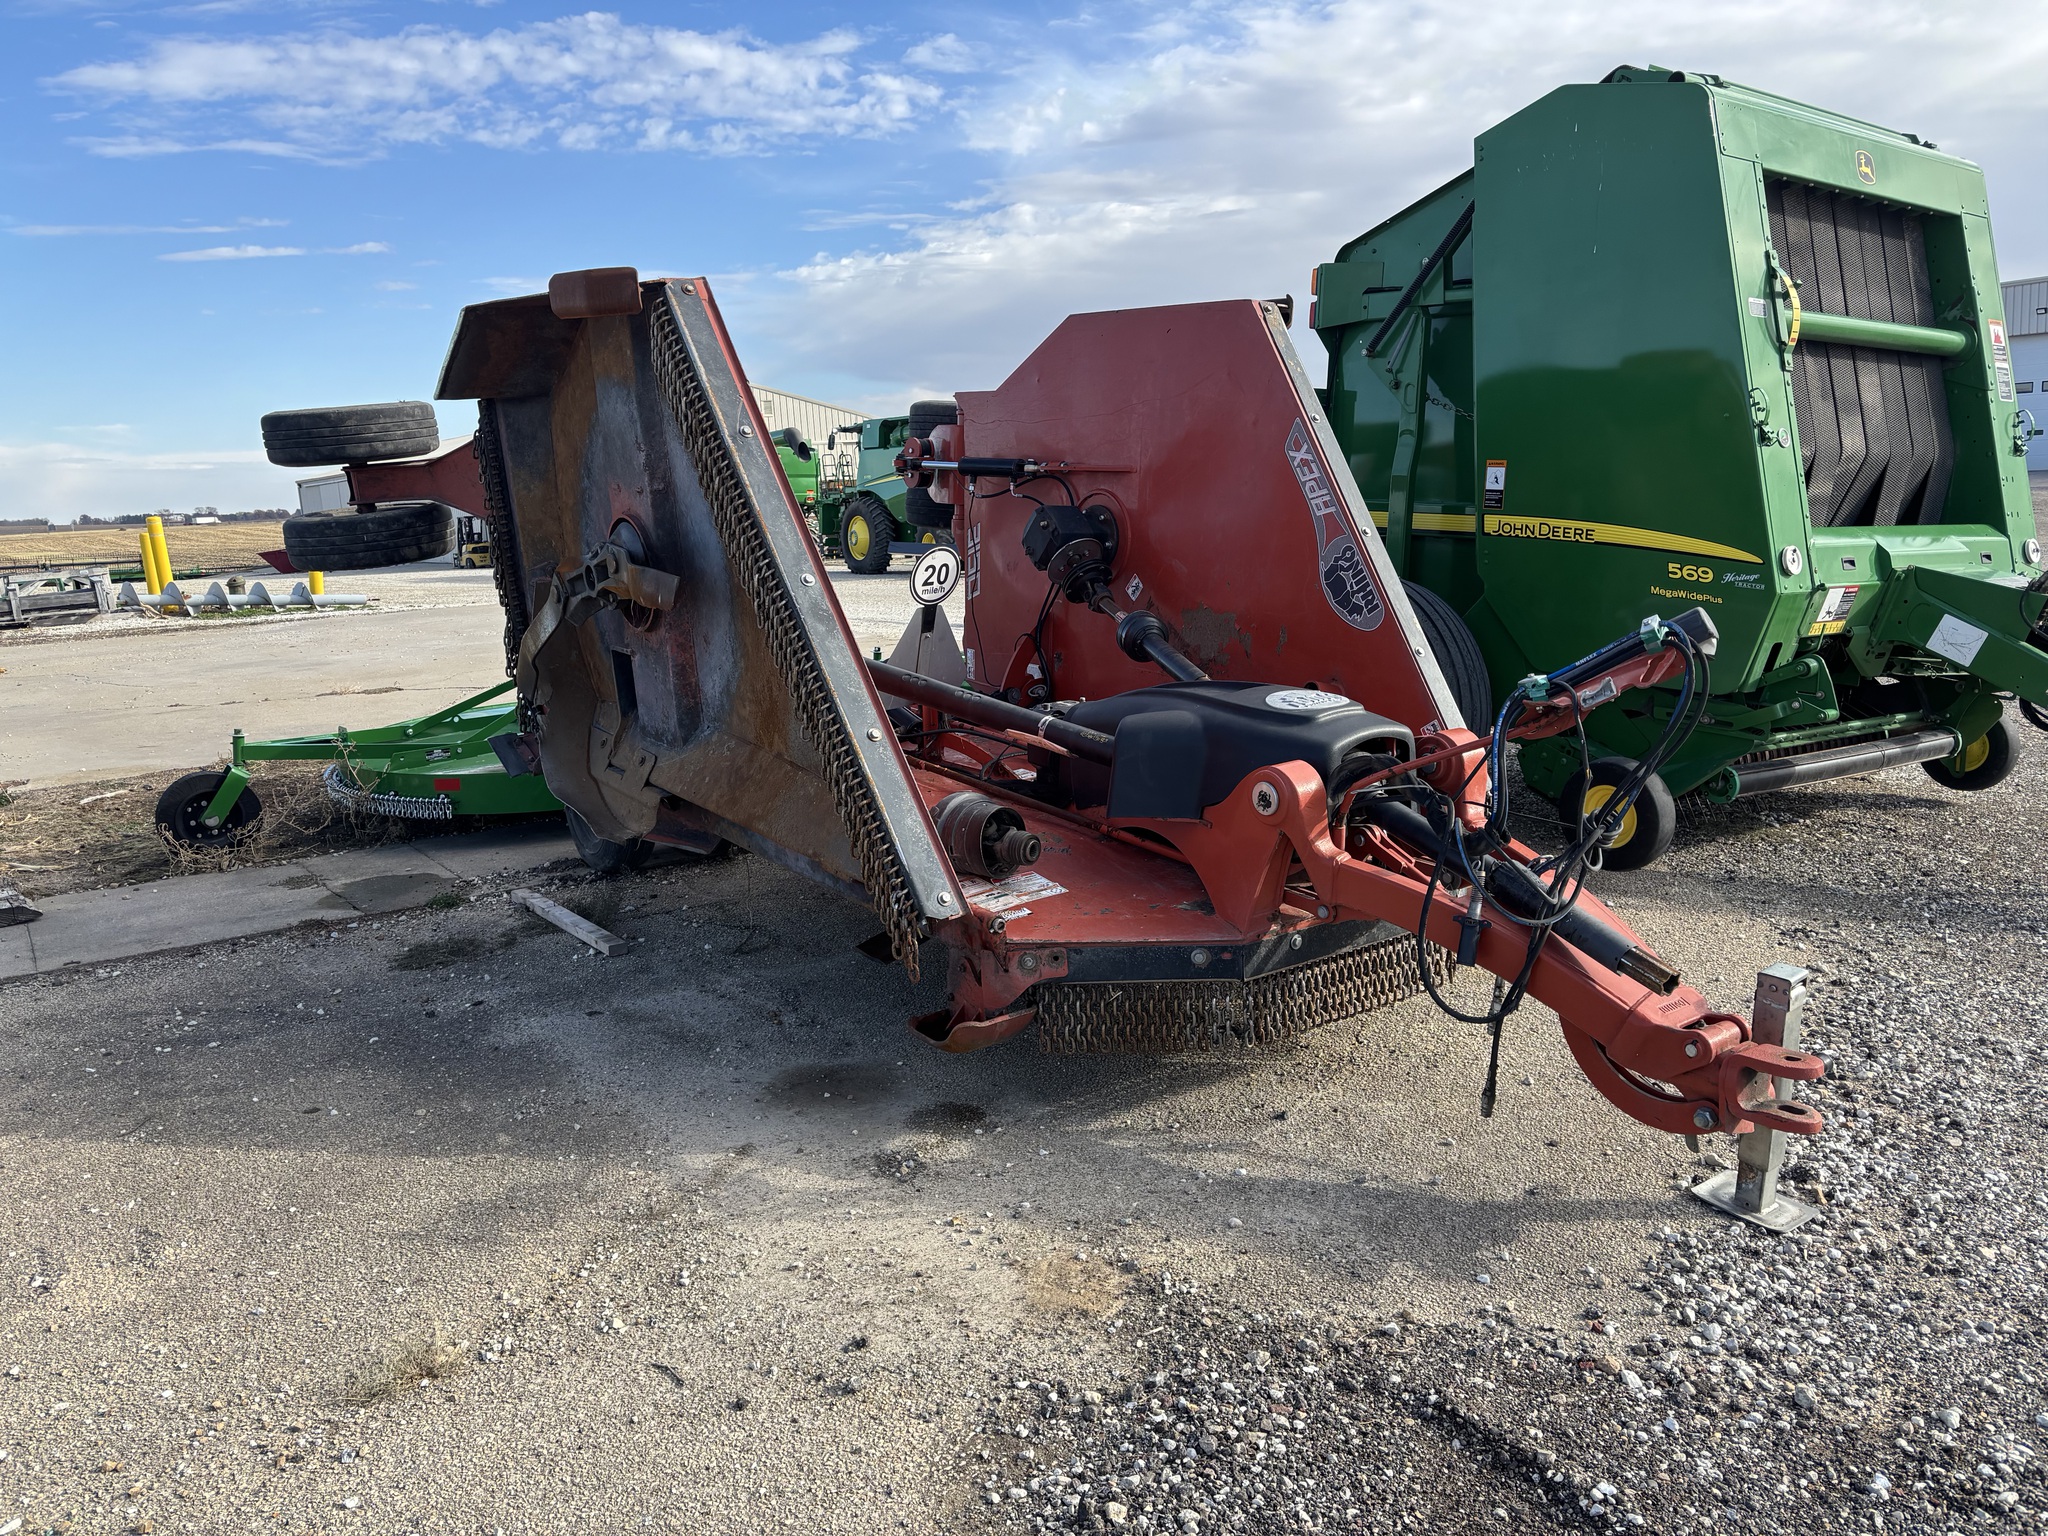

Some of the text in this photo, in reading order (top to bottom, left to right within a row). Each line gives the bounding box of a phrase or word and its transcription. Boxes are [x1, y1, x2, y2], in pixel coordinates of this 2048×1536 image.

[1288, 441, 1336, 517] APEX
[1492, 519, 1596, 541] JOHN DEERE
[922, 562, 950, 587] 20
[1668, 562, 1714, 583] 569
[1720, 571, 1761, 584] Heritage
[921, 585, 946, 595] mile/h
[1650, 585, 1723, 604] MegaWidePlus
[1734, 581, 1766, 591] TRACTOR
